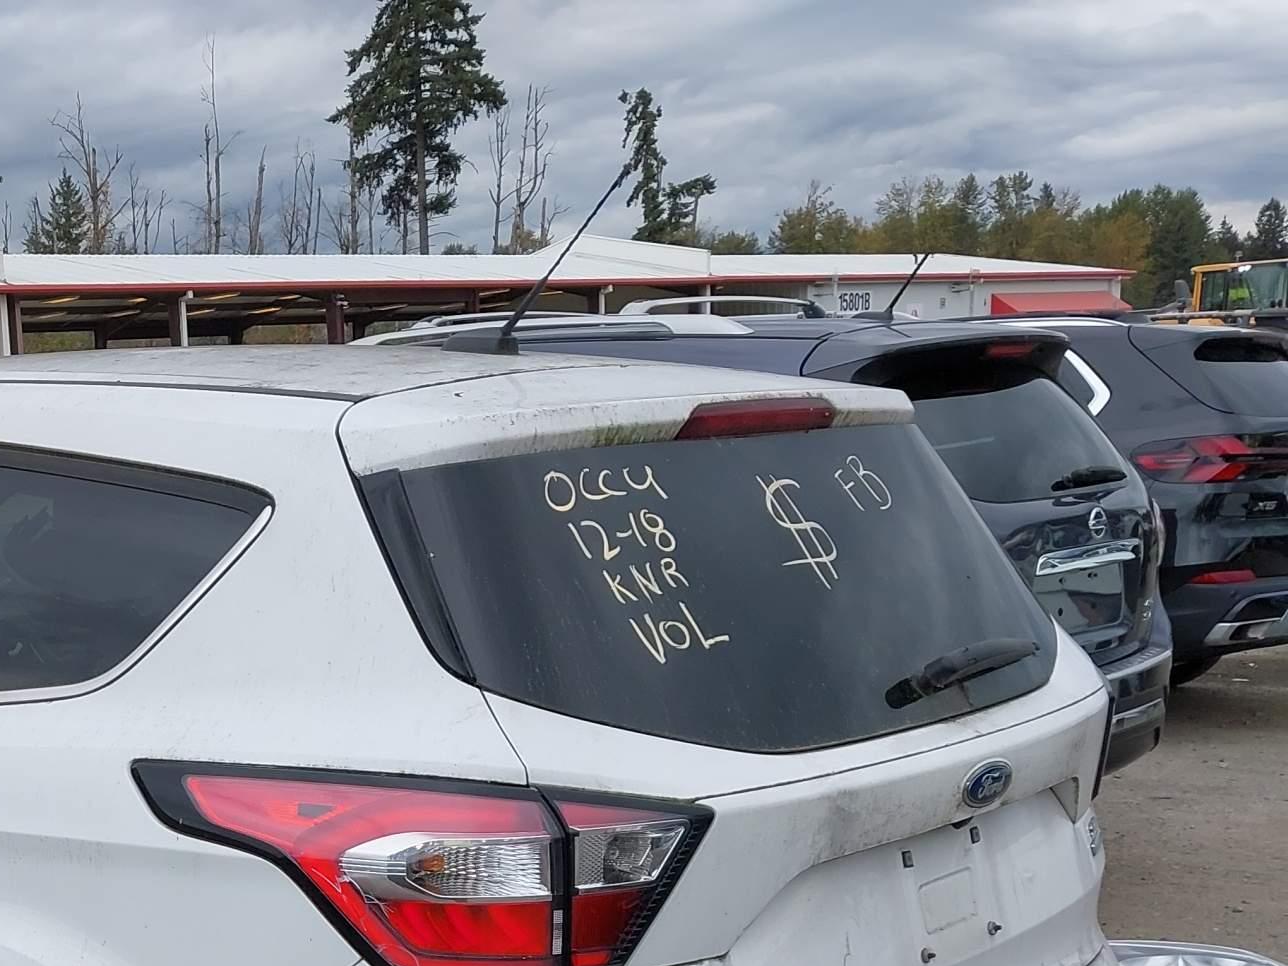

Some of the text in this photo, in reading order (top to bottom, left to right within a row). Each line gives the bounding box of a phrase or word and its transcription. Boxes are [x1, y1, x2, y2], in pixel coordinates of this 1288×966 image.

[838, 292, 871, 312] 15801B
[834, 455, 892, 511] FB
[567, 508, 677, 561] 12-18
[602, 557, 690, 604] KNR
[629, 601, 730, 664] VOL
